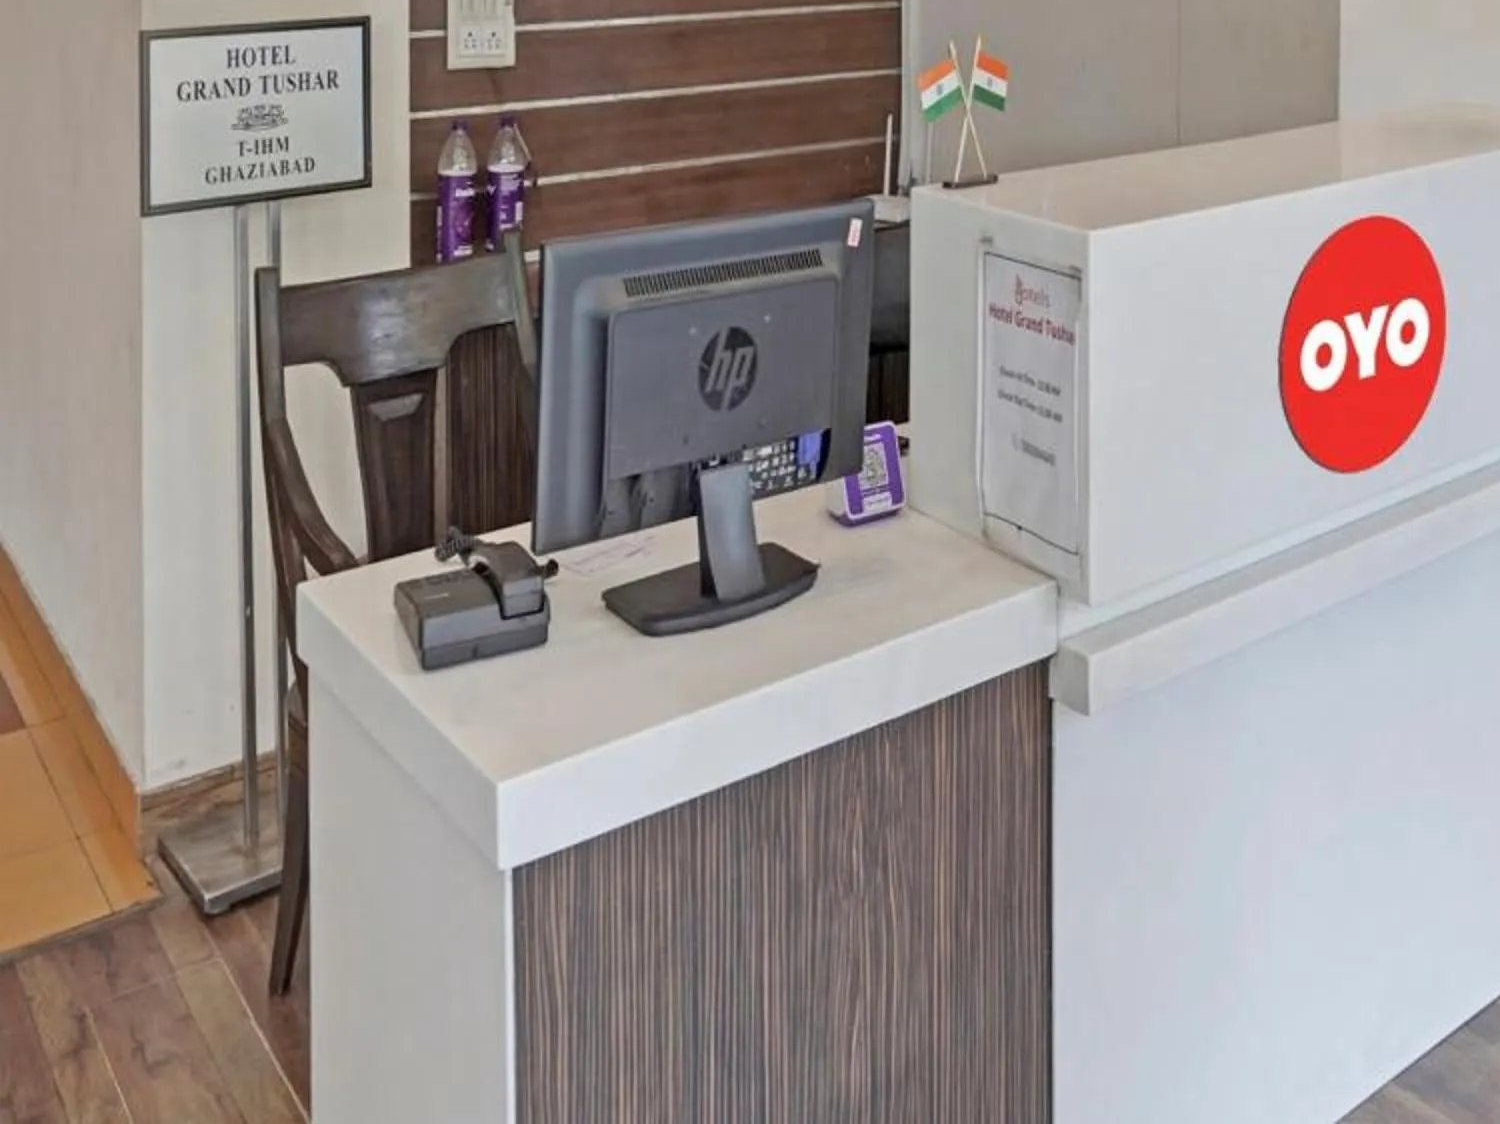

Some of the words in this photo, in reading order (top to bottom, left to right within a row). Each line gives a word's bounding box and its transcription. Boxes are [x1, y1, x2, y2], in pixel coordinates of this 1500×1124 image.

[226, 44, 297, 69] HOTEL
[176, 76, 251, 102] GRAND
[259, 69, 340, 95] TUSHAR
[238, 136, 290, 157] T-IHM
[205, 157, 316, 185] GHAZIABAD
[1300, 297, 1430, 392] OYO
[704, 326, 756, 411] hp
